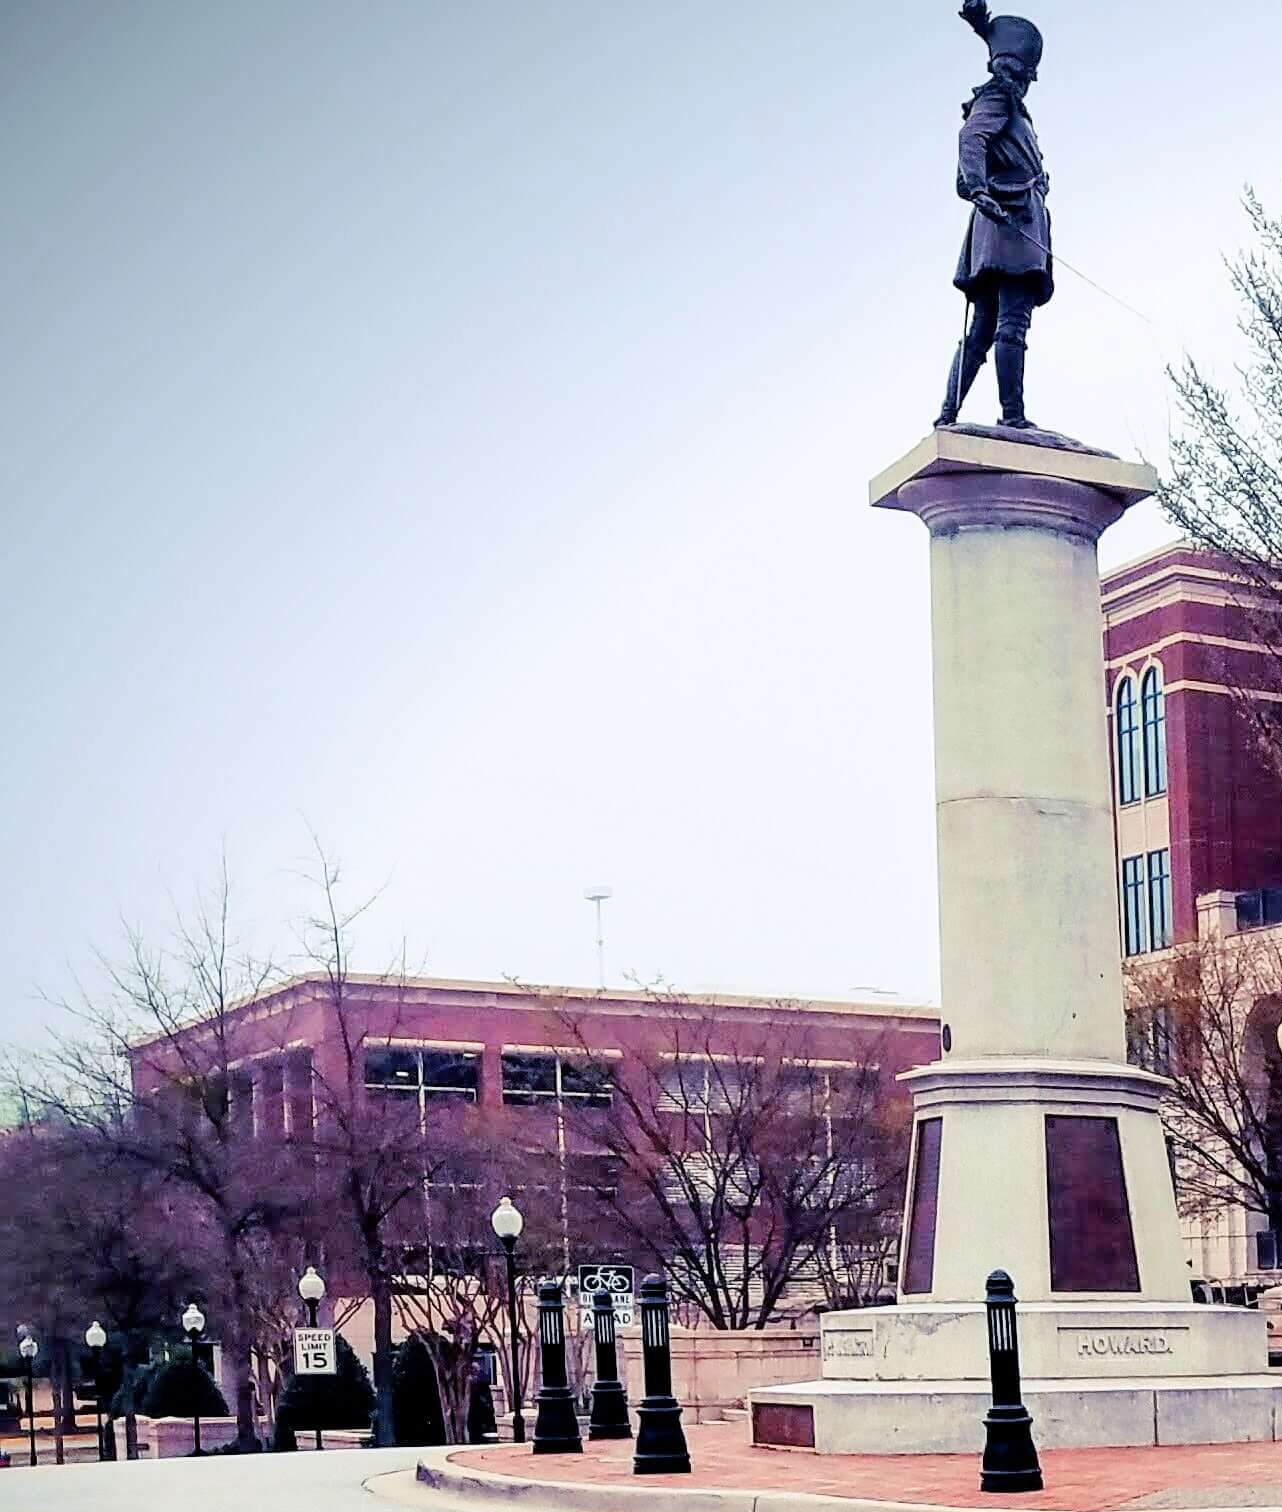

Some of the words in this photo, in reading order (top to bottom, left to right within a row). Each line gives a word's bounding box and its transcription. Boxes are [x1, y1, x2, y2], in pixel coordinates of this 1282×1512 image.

[584, 1312, 631, 1324] AAD
[298, 1333, 331, 1342] SPEED
[301, 1343, 327, 1351] LIMIT
[302, 1352, 328, 1369] 15
